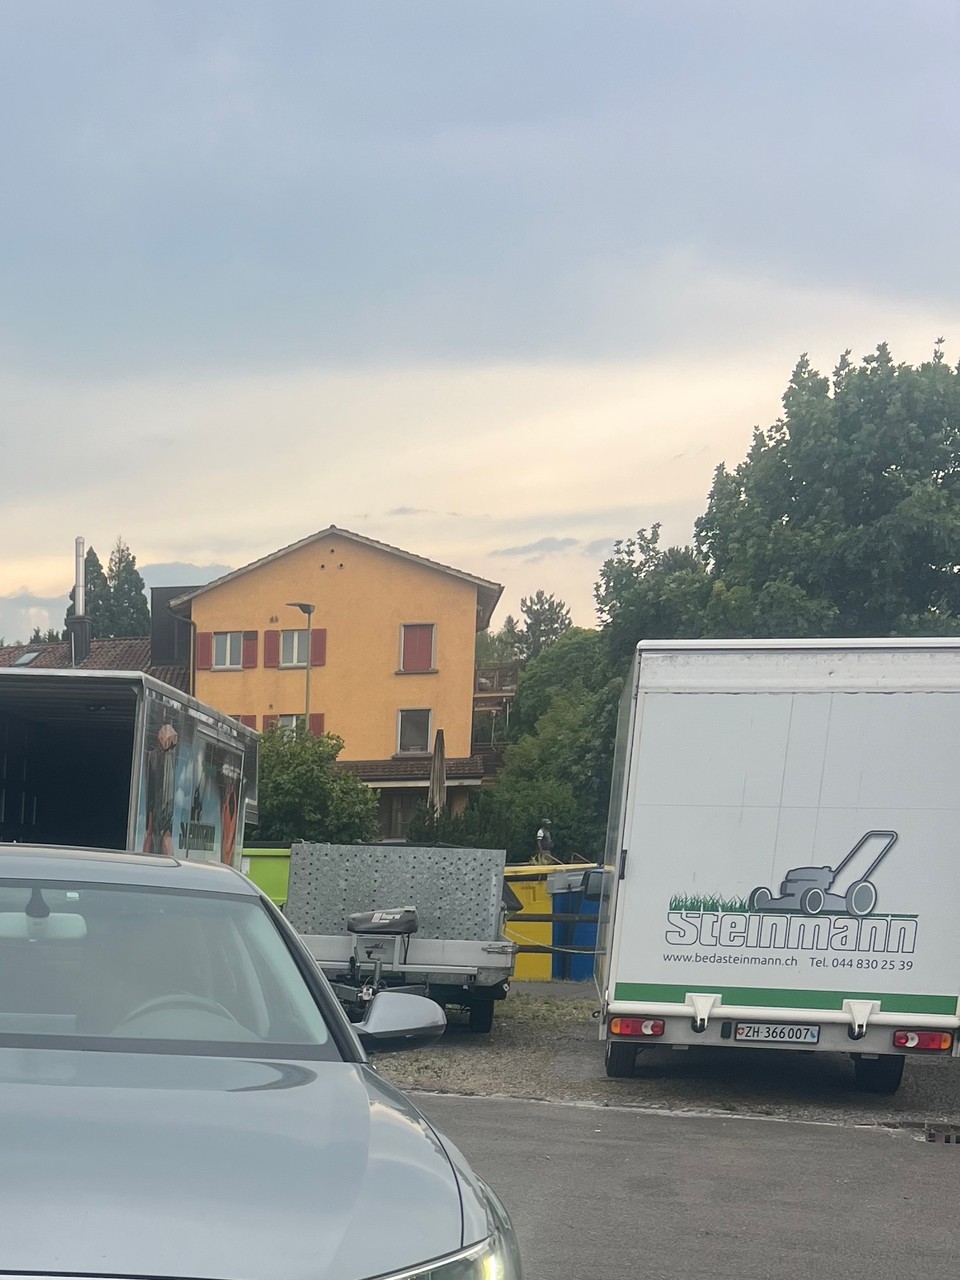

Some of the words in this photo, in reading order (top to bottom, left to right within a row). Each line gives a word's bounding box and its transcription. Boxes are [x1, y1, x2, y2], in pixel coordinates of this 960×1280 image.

[664, 911, 919, 954] Steinmann
[662, 952, 798, 967] www.bedasteinmann.ch
[809, 956, 829, 968] Tel.
[831, 957, 854, 969] 044
[855, 958, 879, 970] 830
[880, 959, 897, 970] 25
[897, 960, 914, 971] 39
